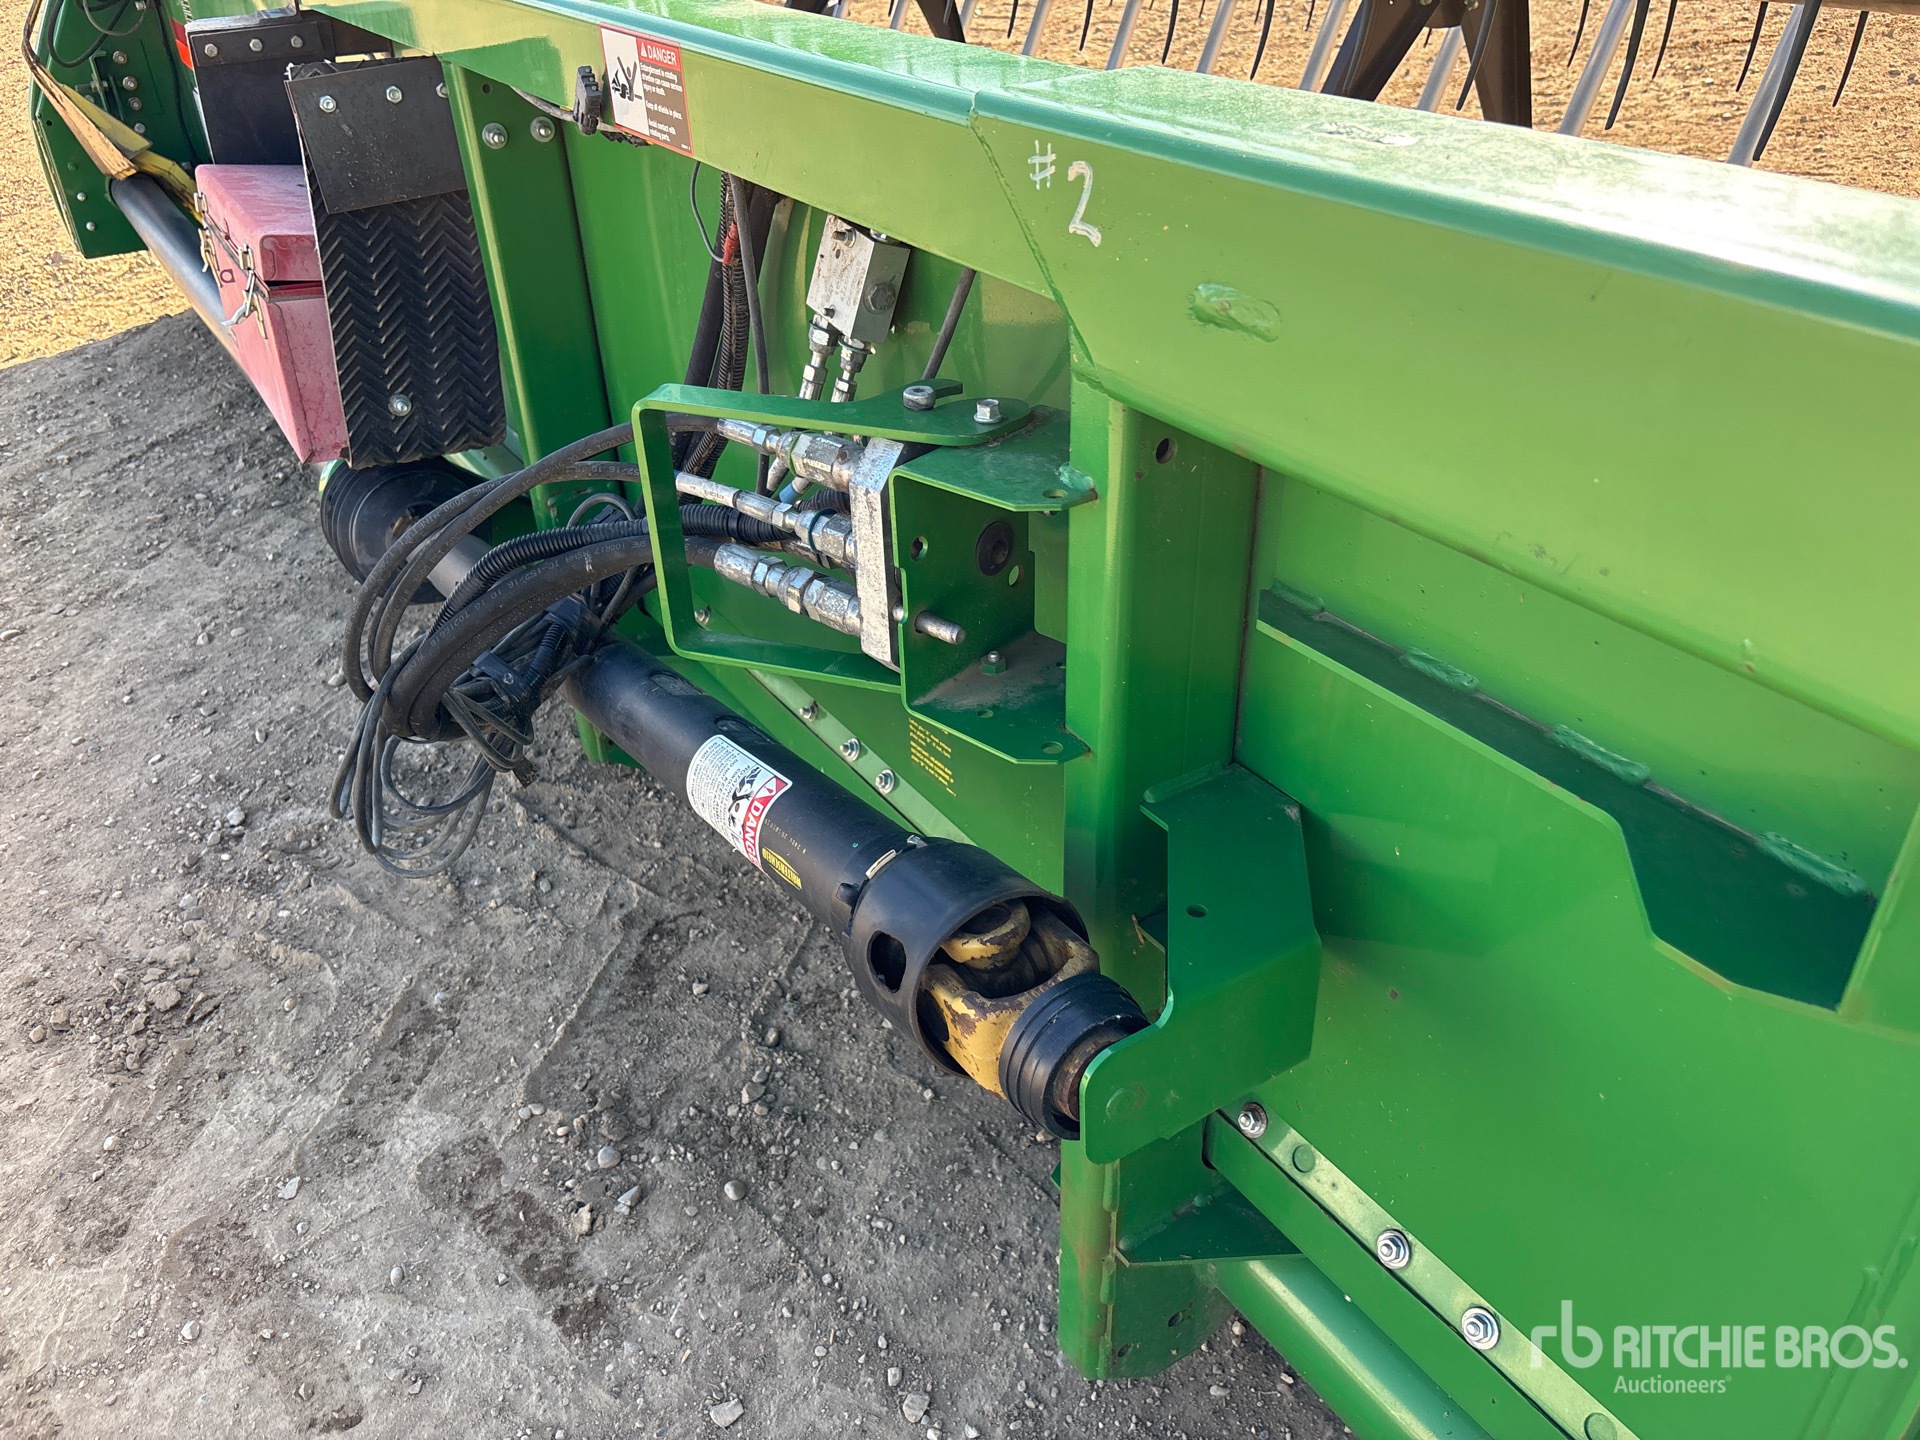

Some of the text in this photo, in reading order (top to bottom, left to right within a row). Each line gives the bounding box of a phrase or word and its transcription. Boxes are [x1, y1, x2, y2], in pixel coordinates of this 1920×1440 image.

[647, 44, 677, 66] DANGER
[594, 542, 625, 554] 100R17
[631, 540, 646, 548] SAE
[564, 550, 589, 562] MSHA
[744, 800, 764, 866] DANGE
